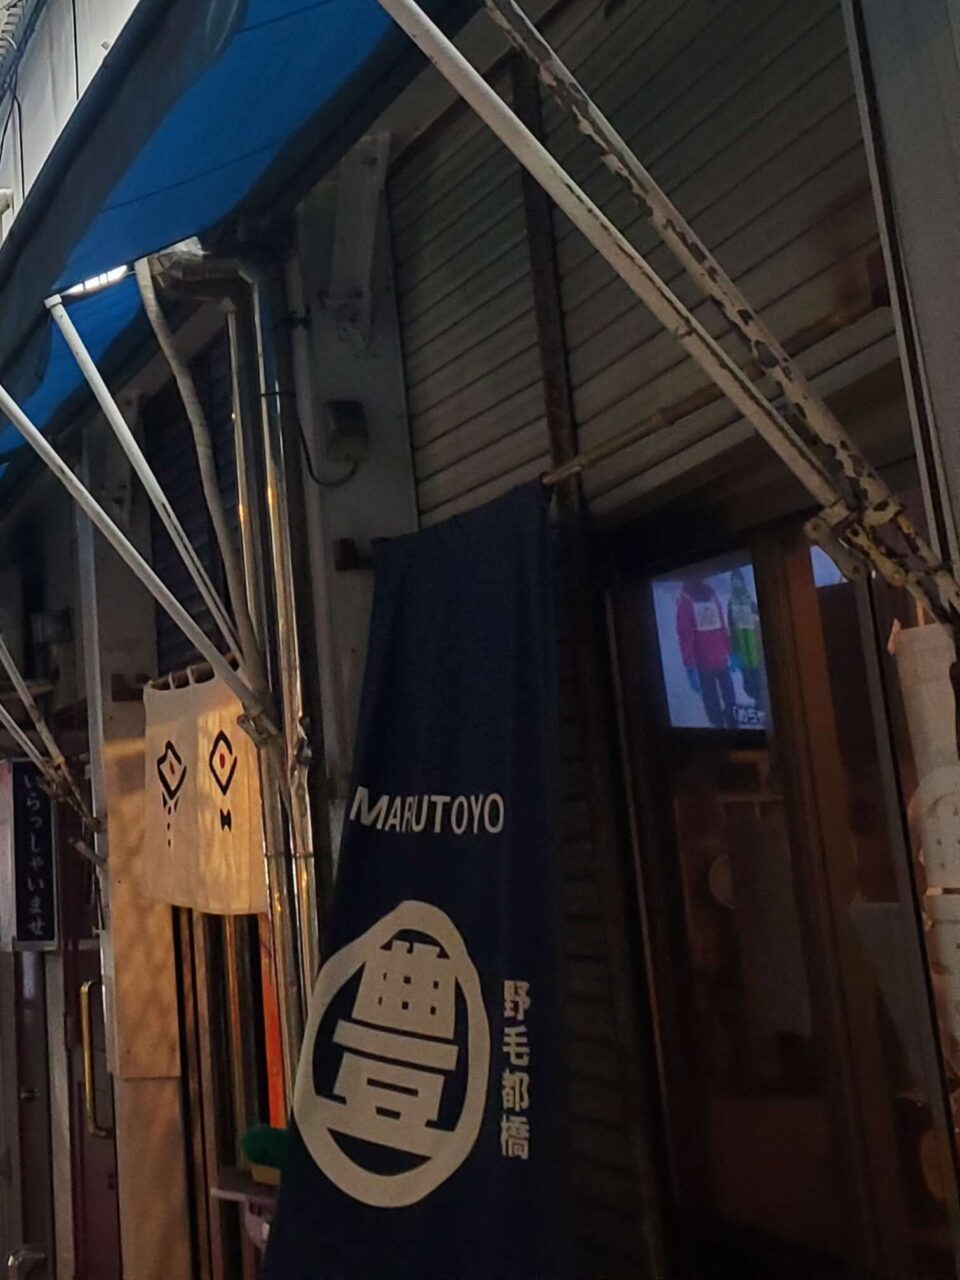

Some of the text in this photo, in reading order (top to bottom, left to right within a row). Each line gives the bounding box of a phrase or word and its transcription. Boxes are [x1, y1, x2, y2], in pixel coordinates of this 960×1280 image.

[349, 785, 505, 835] MARUTOYO
[500, 980, 531, 1160] 野毛都橋
